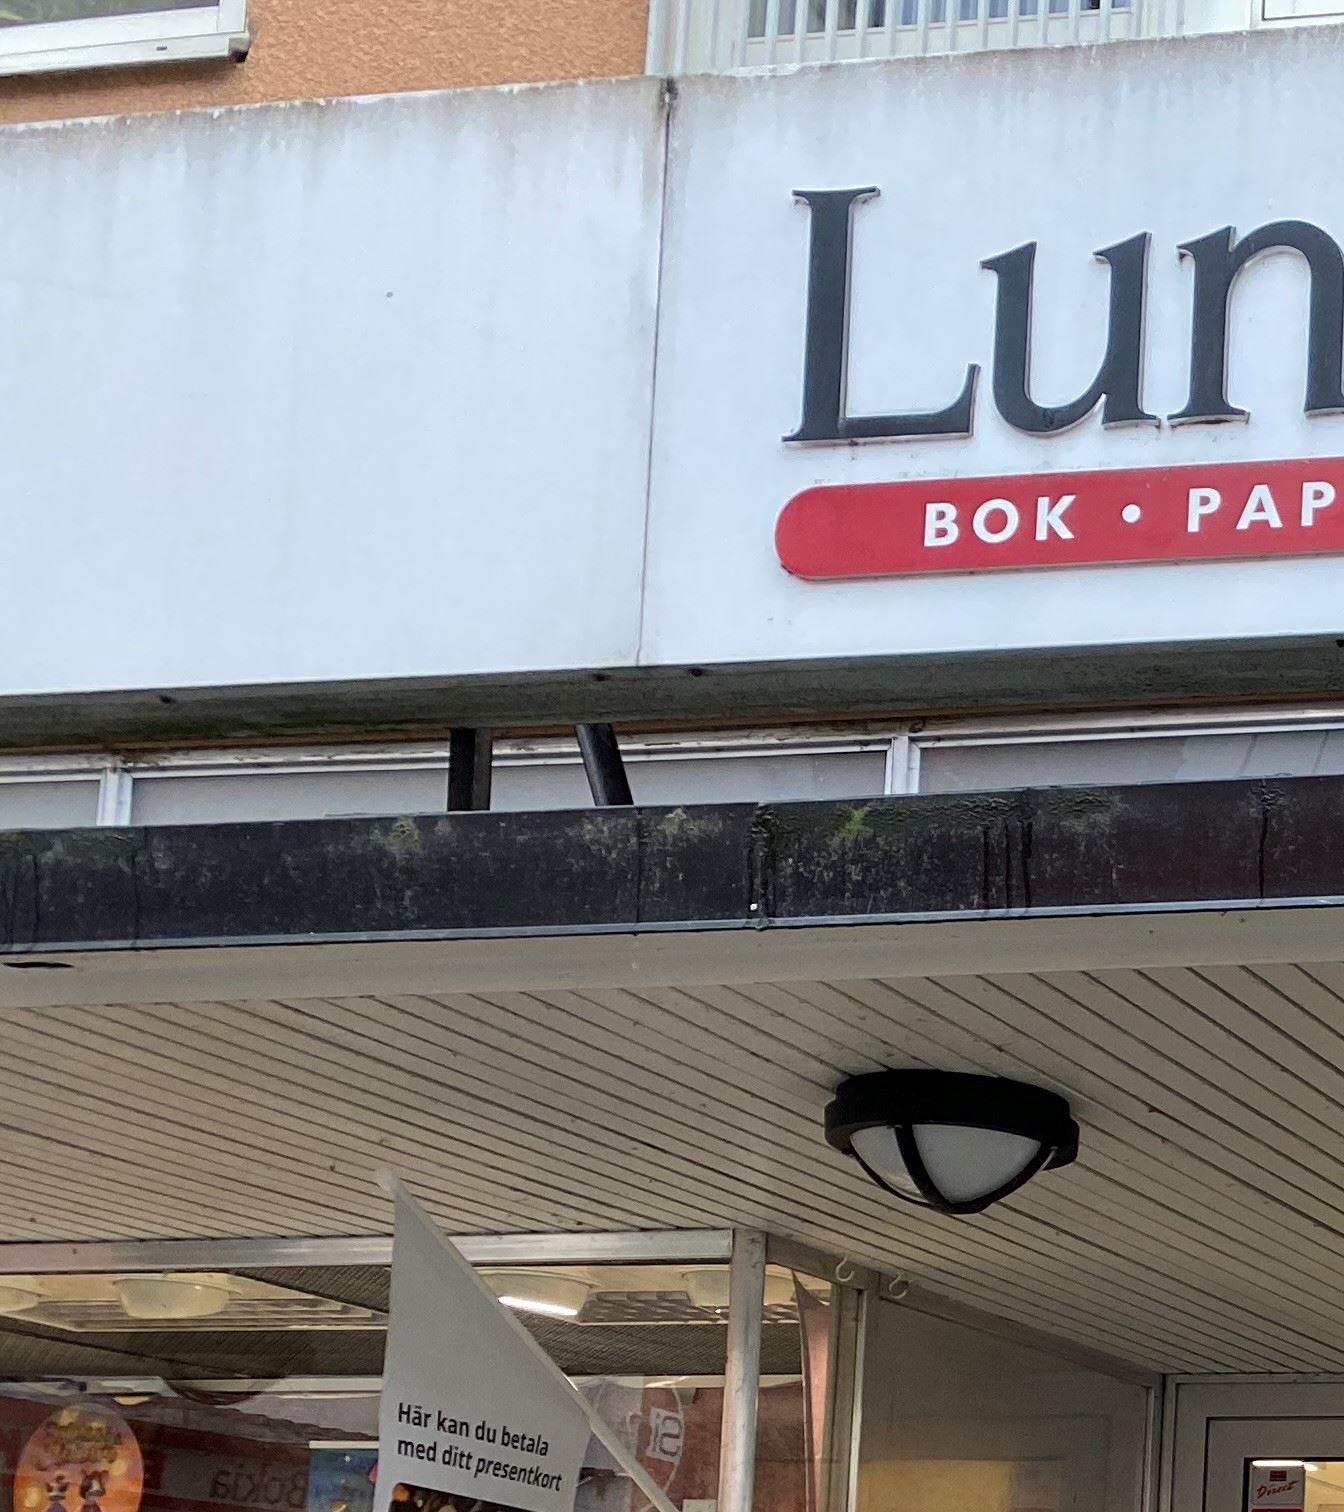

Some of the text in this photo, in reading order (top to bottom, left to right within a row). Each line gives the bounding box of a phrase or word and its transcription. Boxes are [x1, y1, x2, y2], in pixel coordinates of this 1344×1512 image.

[922, 492, 1076, 549] BOK
[398, 1402, 550, 1457] Här kan du betala
[397, 1438, 563, 1492] med ditt presentkort
